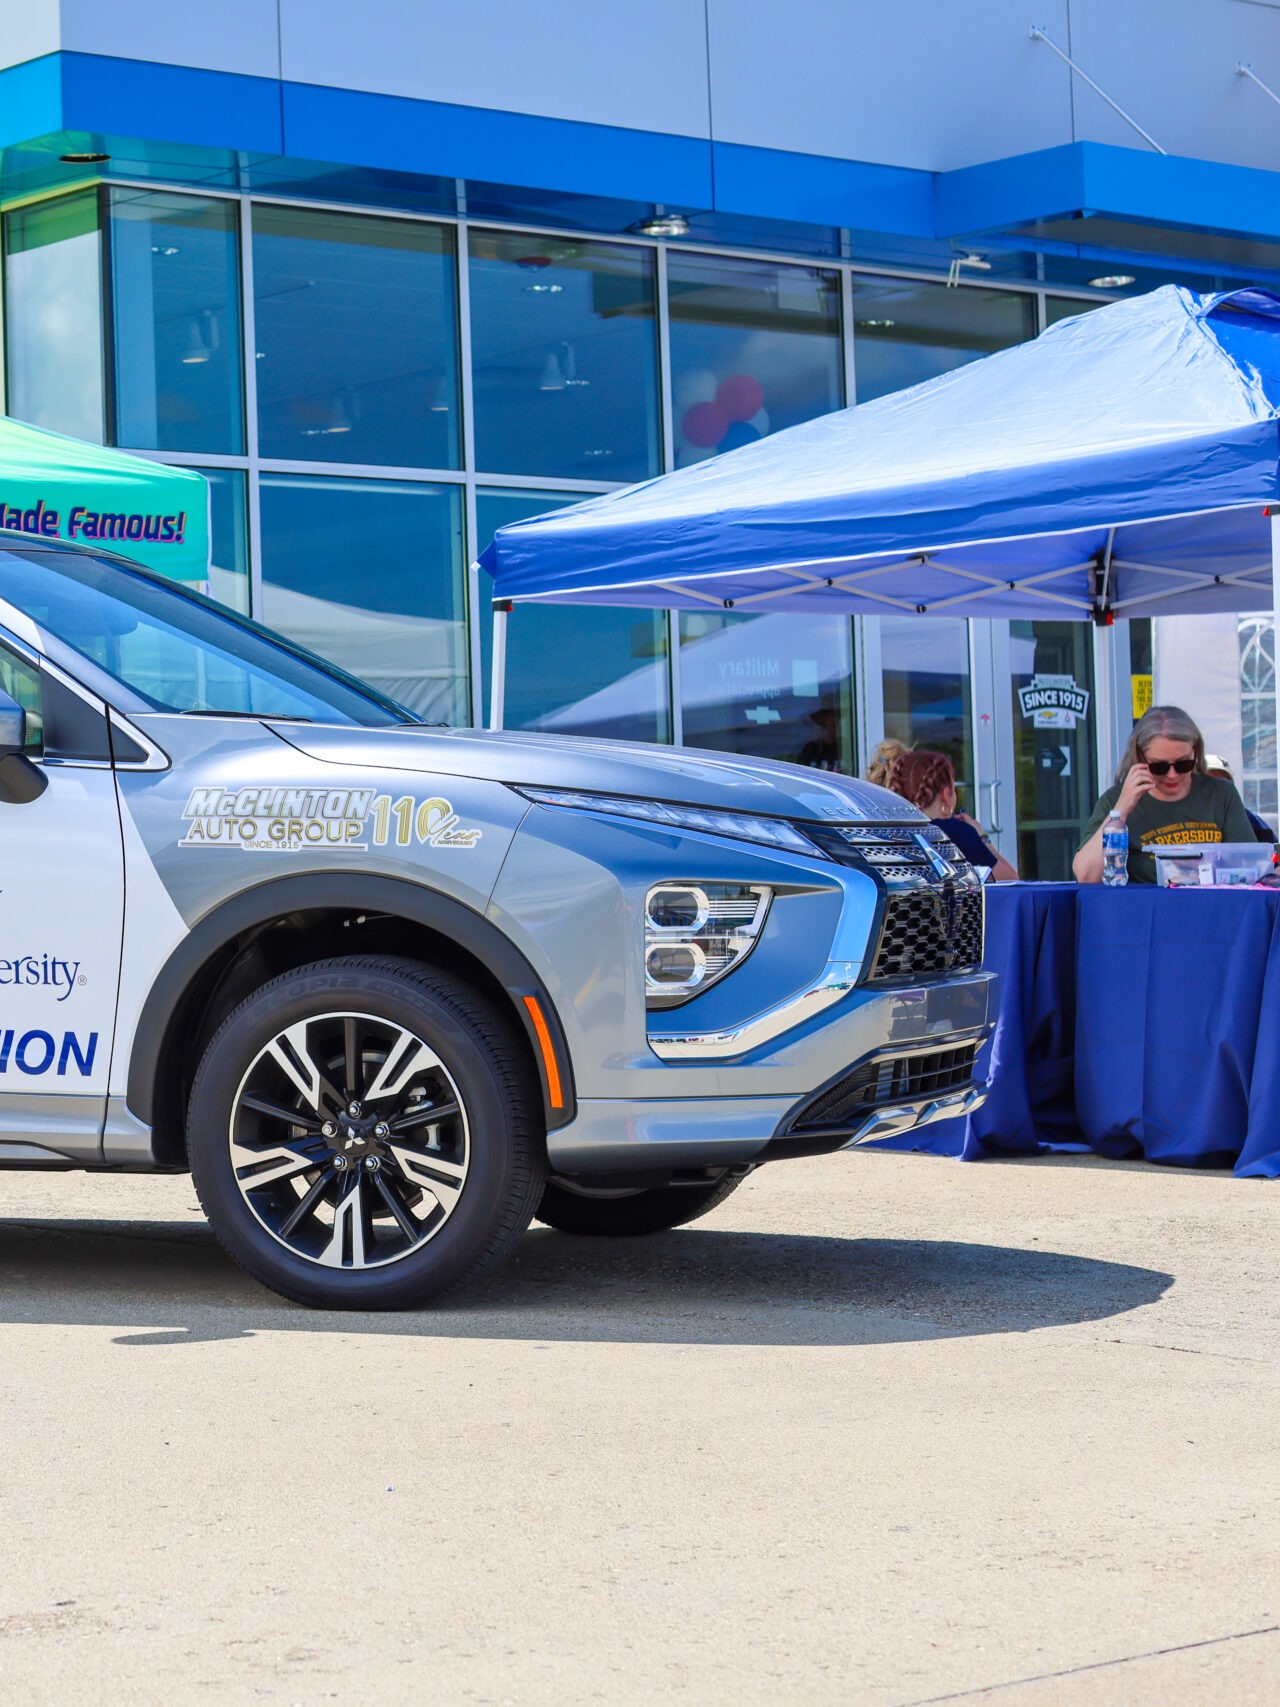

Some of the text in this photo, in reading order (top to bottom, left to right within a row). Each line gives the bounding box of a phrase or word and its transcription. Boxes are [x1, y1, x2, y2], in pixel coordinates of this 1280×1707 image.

[68, 506, 187, 544] Famous!
[1024, 690, 1083, 710] SINCE 1915
[189, 818, 362, 843] AUTO GROUP
[371, 797, 451, 844] 110
[244, 840, 299, 849] SINCE 1915
[1141, 830, 1223, 846] RKERSBUR
